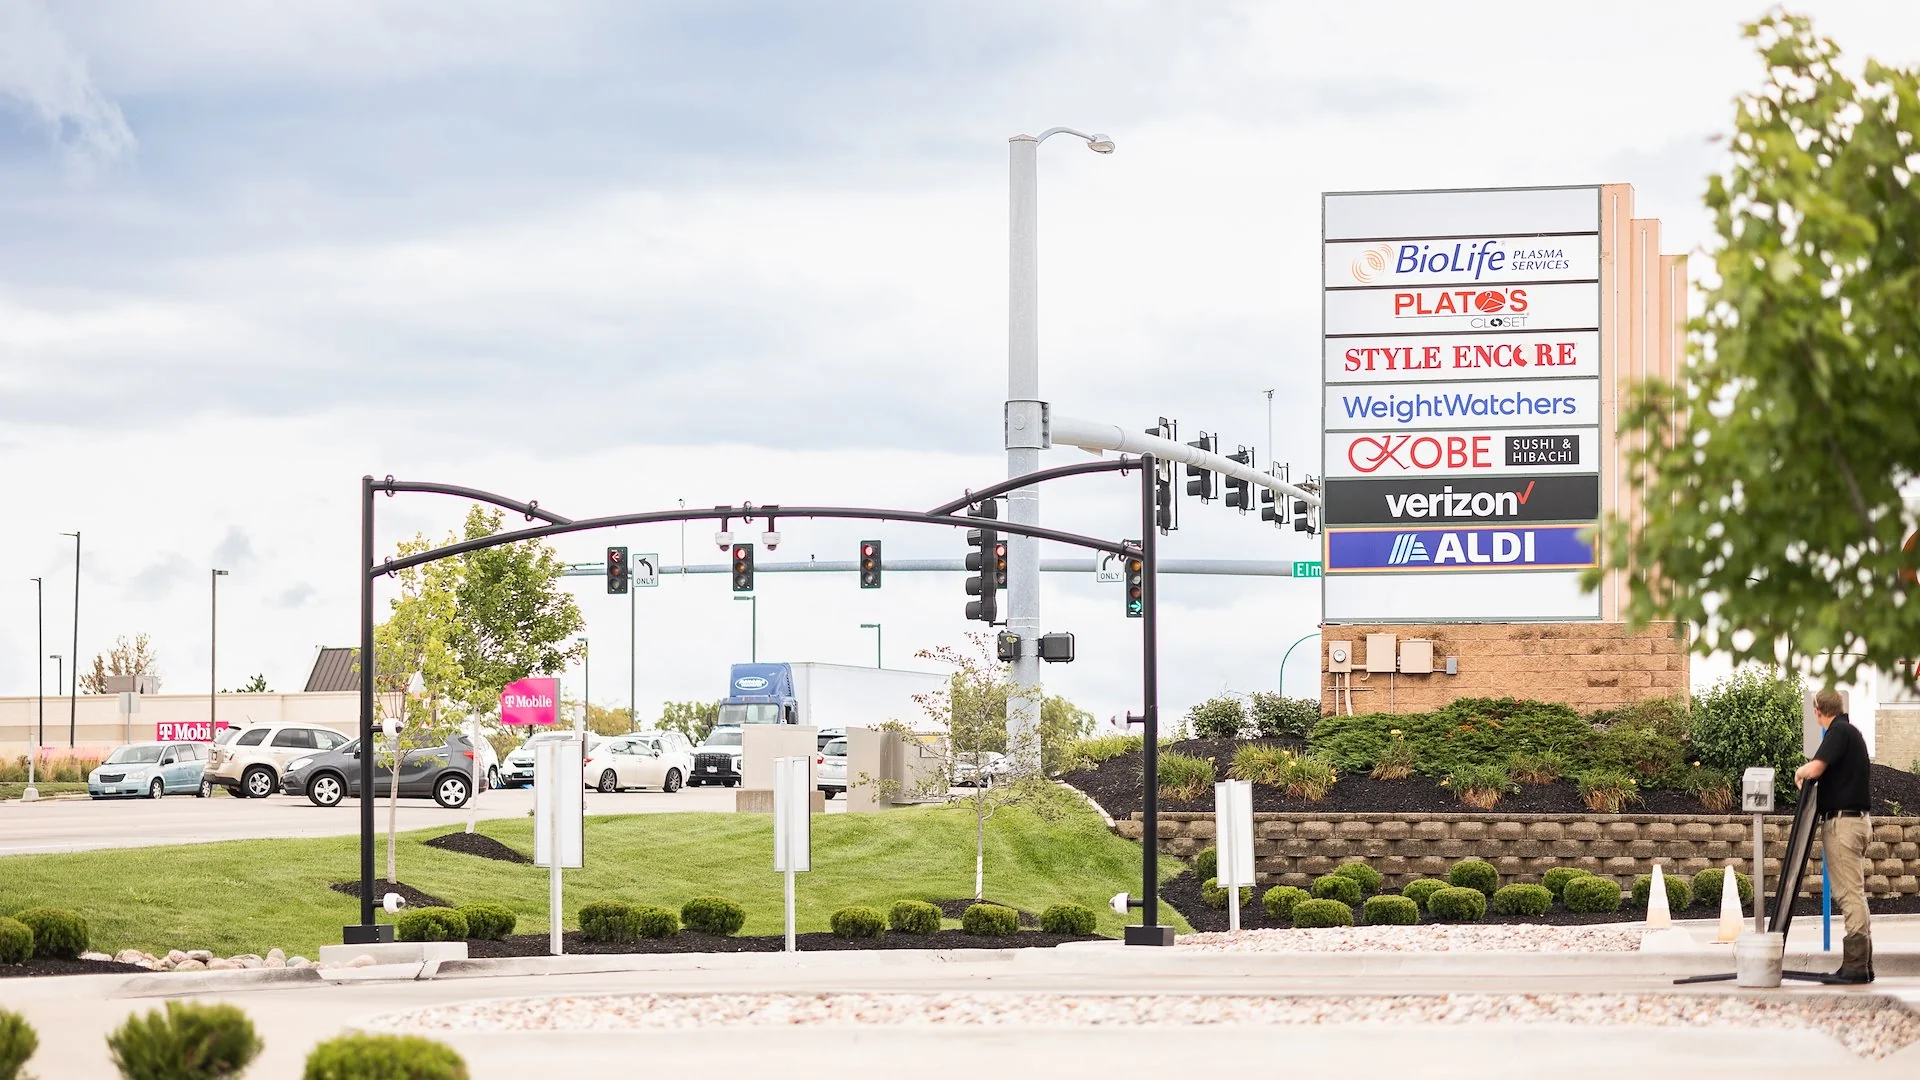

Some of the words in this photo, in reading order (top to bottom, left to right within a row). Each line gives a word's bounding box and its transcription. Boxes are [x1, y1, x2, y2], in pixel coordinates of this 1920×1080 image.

[1396, 240, 1505, 280] BioLife
[1513, 249, 1563, 259] PLASMA
[1512, 260, 1569, 271] SERVICES
[1395, 288, 1528, 315] PLATO'S
[1470, 316, 1528, 329] CLOSET
[1345, 346, 1442, 372] STYLE
[1342, 391, 1576, 423] WeightWatchers
[1513, 438, 1554, 450] SUSHI
[1563, 438, 1572, 449] &
[1348, 435, 1492, 473] KOBE
[1513, 451, 1572, 463] HIBACHI
[1385, 485, 1518, 518] verizon
[1433, 531, 1535, 564] ALDI
[1100, 572, 1120, 580] ONLY
[1297, 562, 1322, 577] Elm
[636, 577, 655, 585] ONLY
[515, 694, 553, 708] Mobile
[174, 722, 225, 741] Mobie
